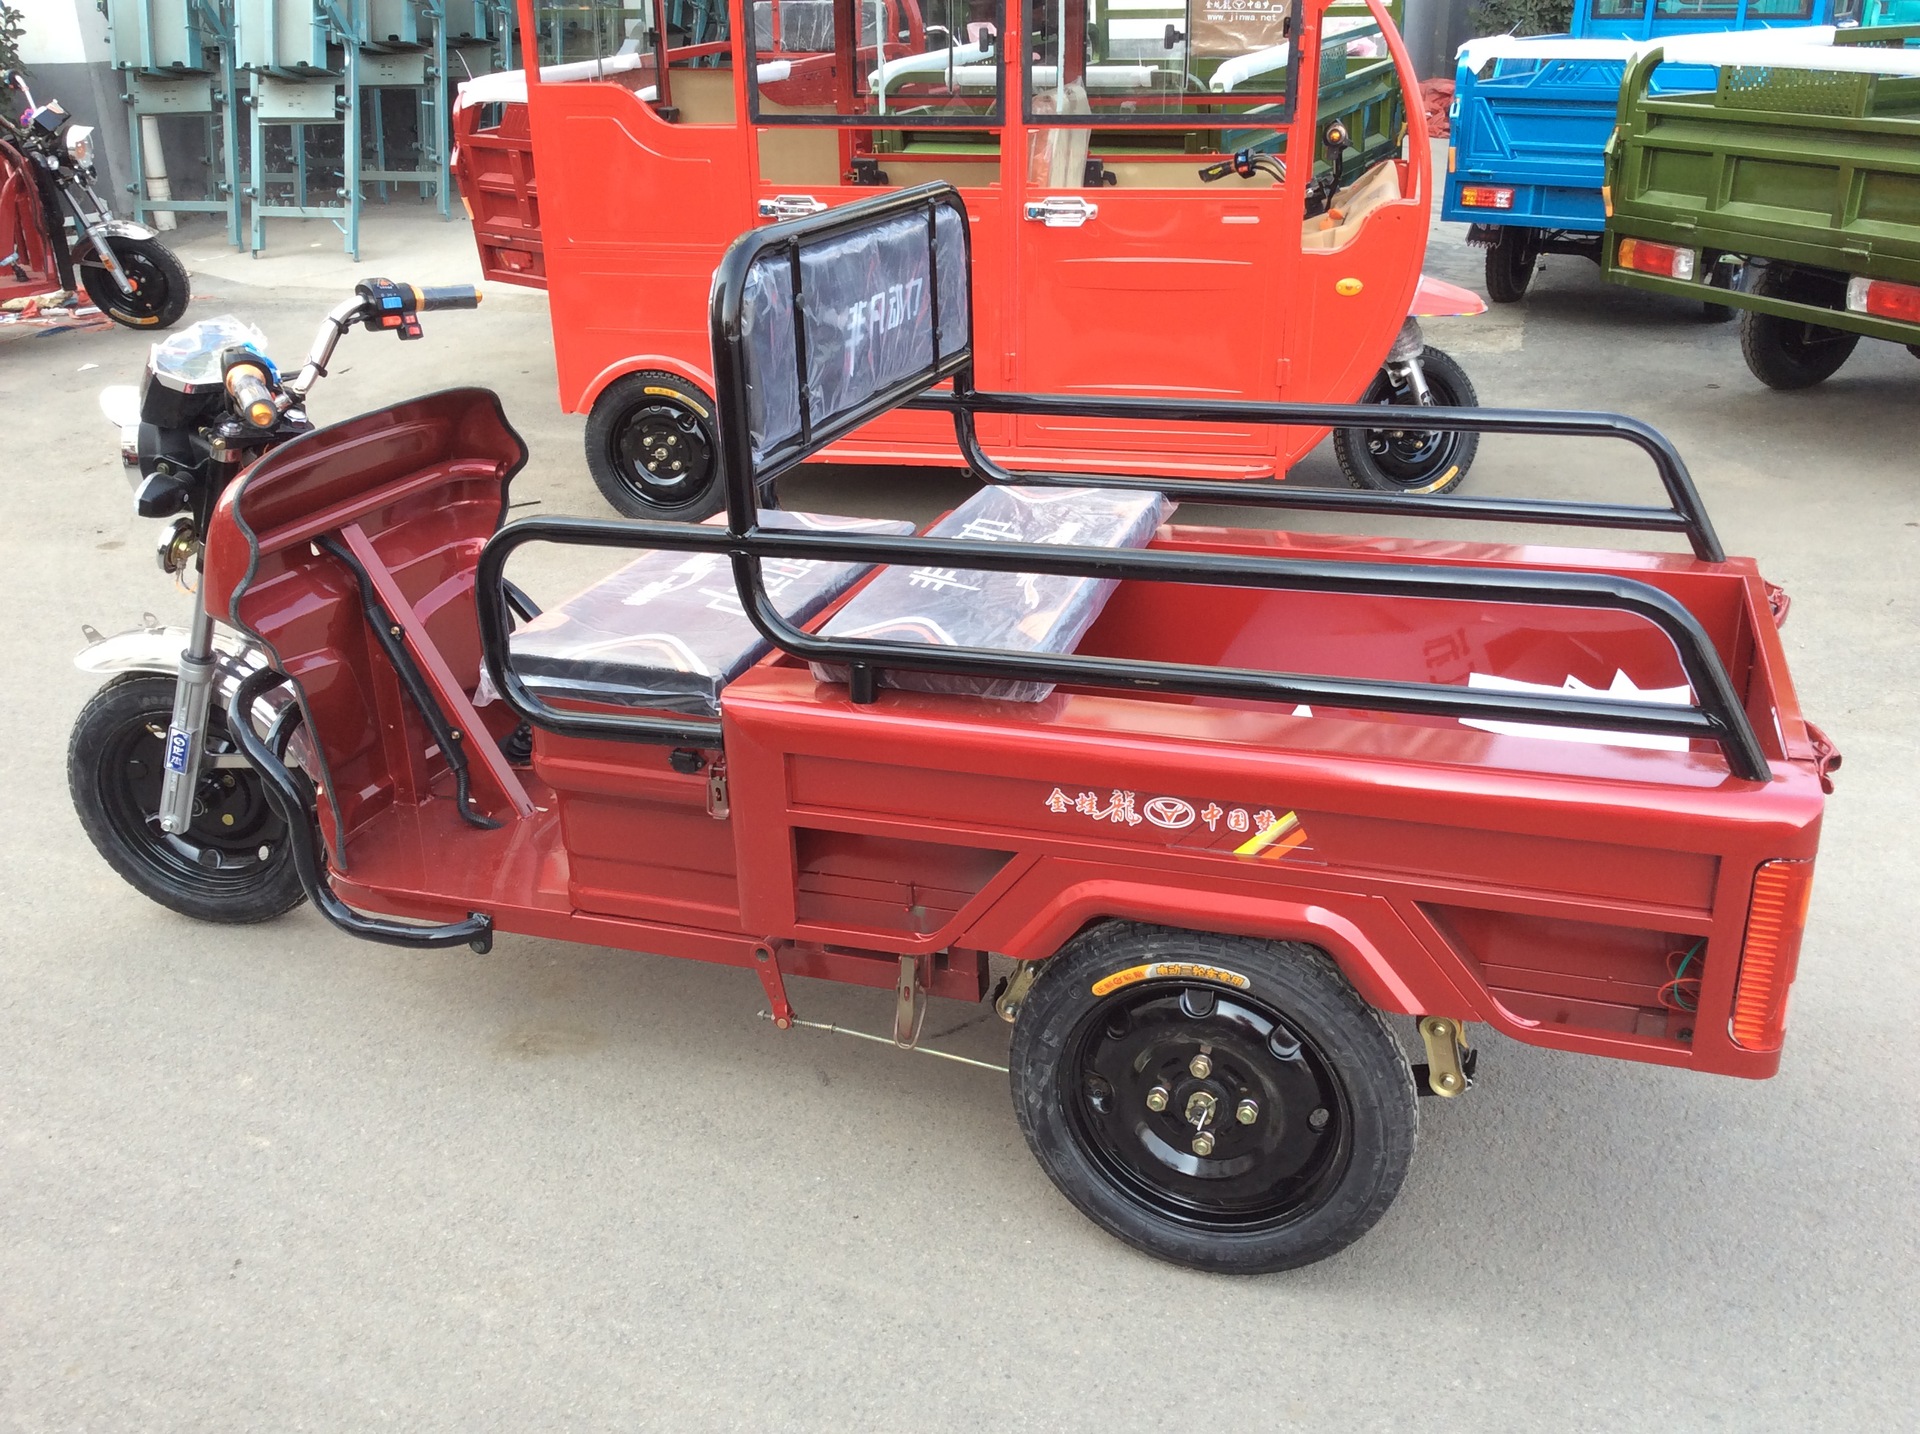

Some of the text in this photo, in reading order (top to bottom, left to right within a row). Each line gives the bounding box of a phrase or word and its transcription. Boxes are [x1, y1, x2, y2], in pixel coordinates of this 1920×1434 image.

[1207, 12, 1277, 22] www.jinwa.net
[1201, 802, 1277, 835] 中国梦
